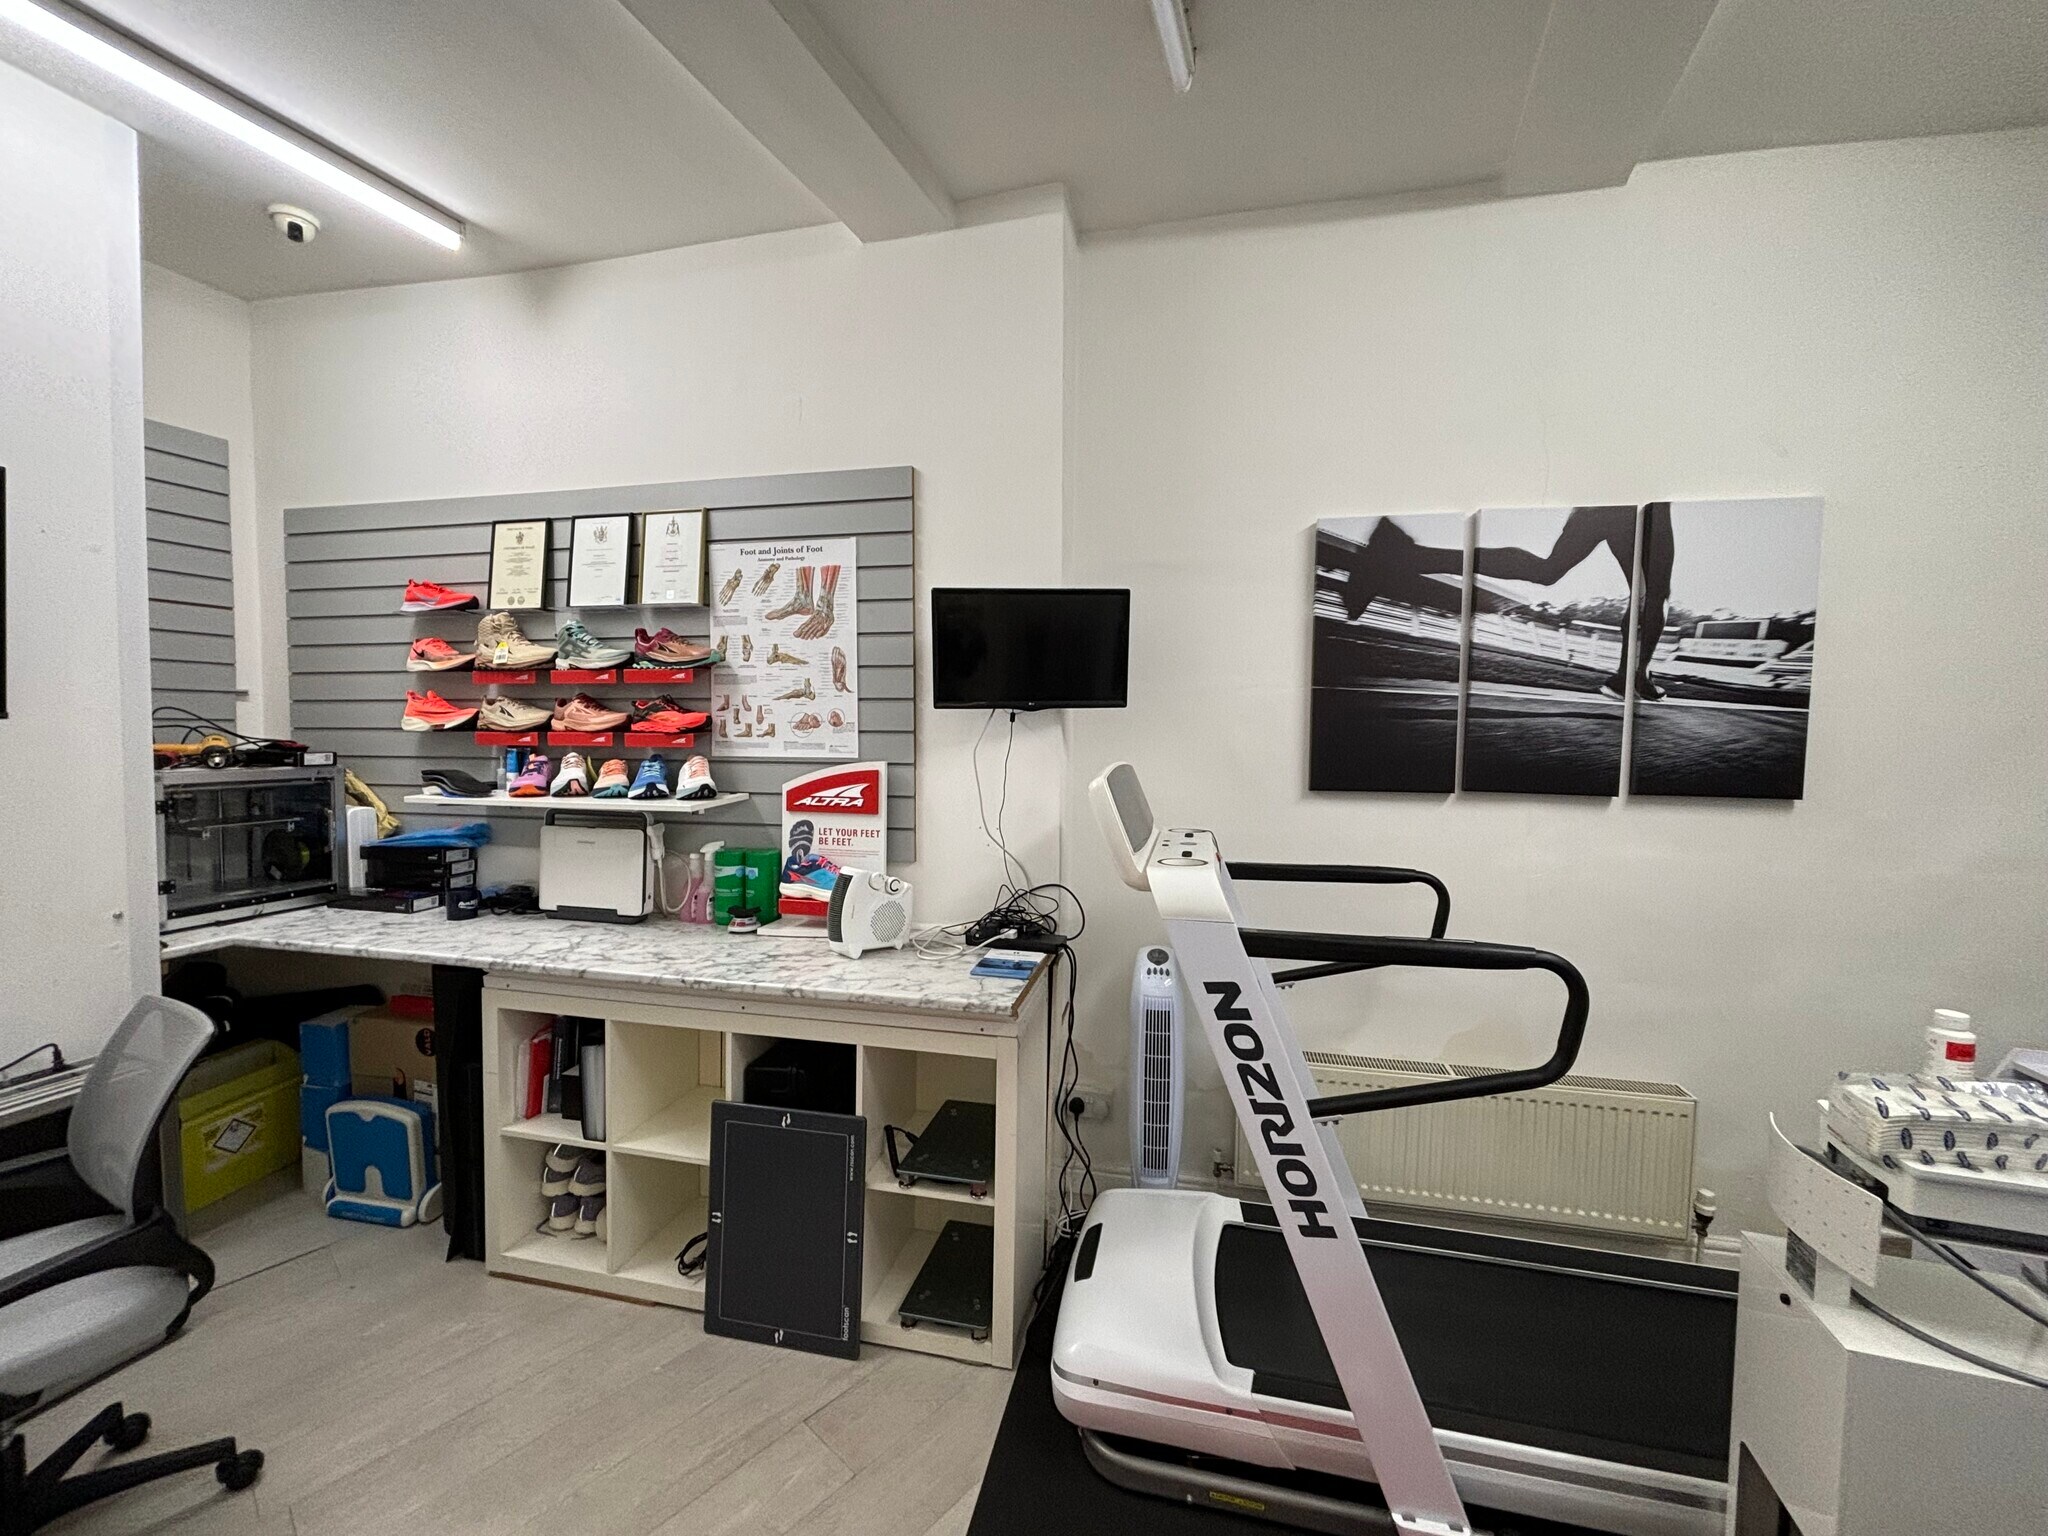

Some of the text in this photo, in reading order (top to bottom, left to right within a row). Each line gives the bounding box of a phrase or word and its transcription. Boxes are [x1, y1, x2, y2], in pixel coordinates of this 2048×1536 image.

[740, 545, 823, 557] Foot and Joints of Foot
[794, 797, 864, 807] ALTRA
[818, 827, 881, 839] LET YOUR FEET
[818, 837, 854, 847] BE FEET.
[1203, 981, 1338, 1239] HORIZON
[842, 1307, 850, 1341] footscan
